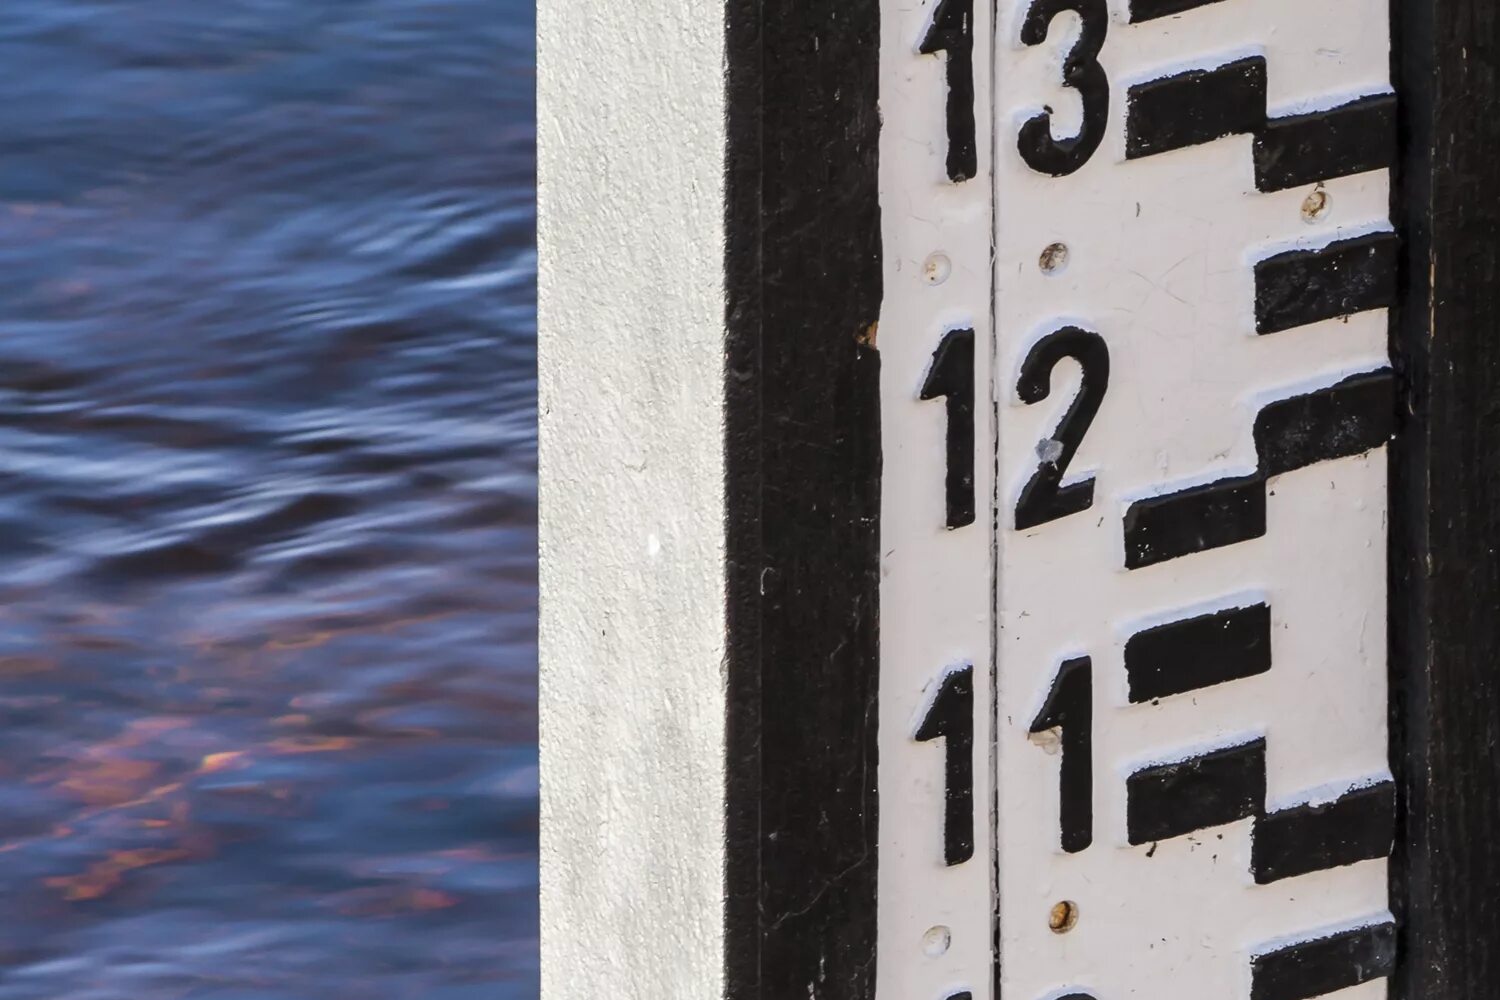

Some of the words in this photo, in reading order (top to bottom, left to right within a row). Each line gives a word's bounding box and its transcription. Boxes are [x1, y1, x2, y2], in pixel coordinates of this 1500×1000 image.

[918, 0, 1109, 183] 13
[919, 324, 1111, 531] 12
[914, 654, 1093, 867] 11
